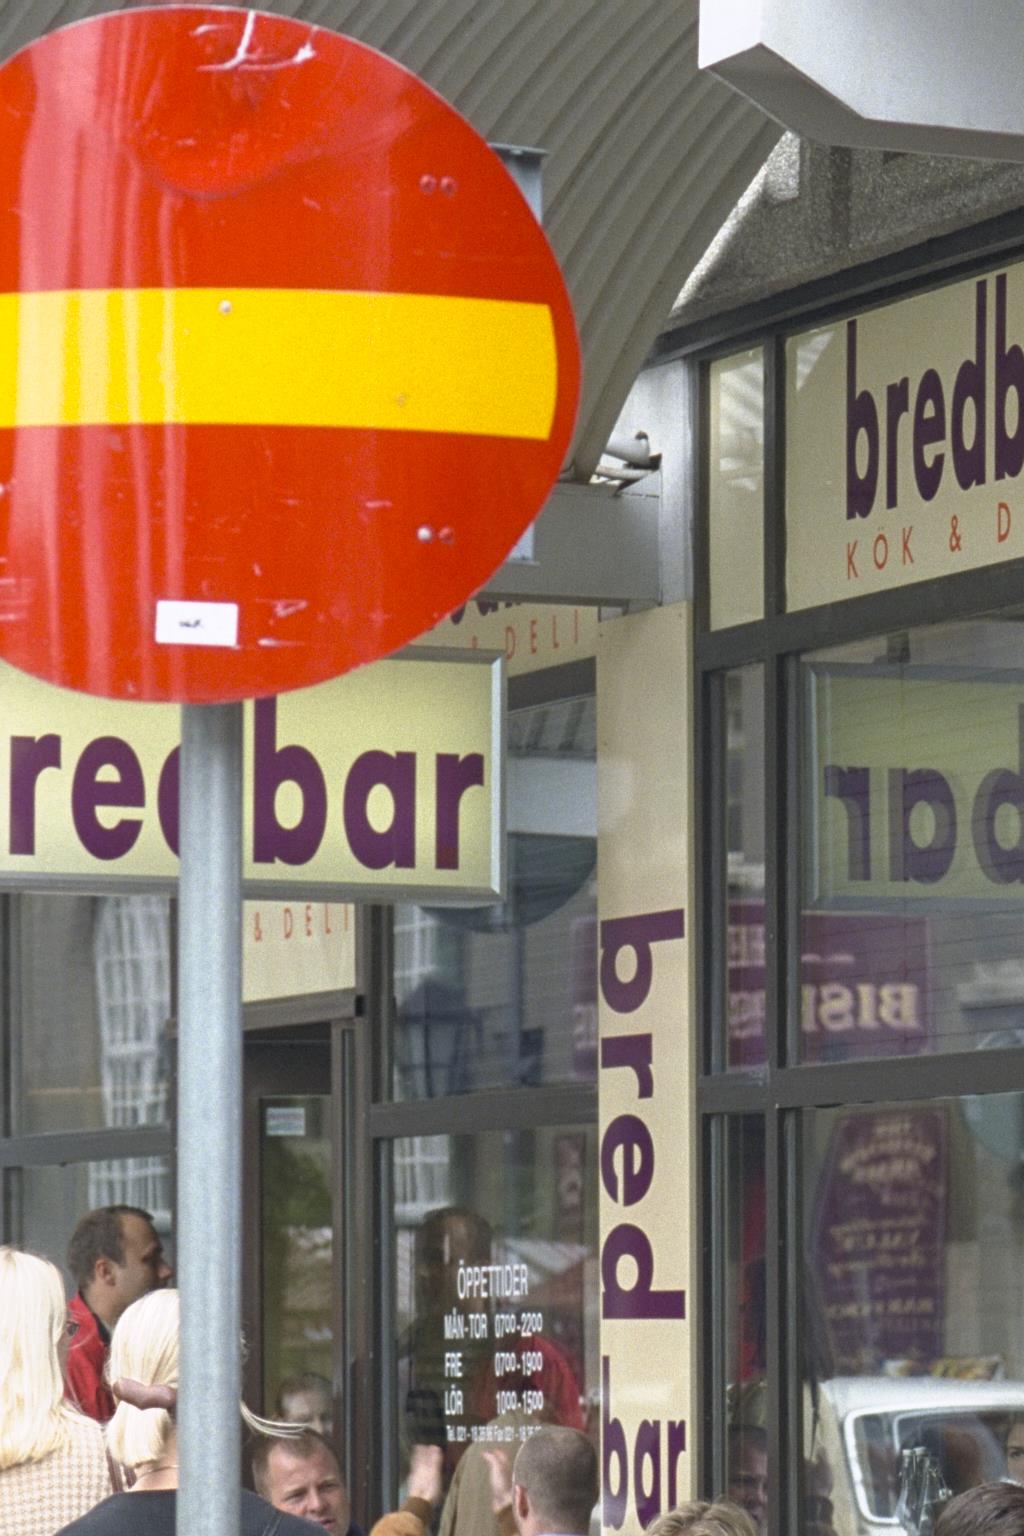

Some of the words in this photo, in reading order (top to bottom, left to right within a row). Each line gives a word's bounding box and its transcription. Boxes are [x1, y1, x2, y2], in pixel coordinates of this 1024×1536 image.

[846, 525, 914, 580] KÖK
[949, 514, 962, 552] &
[504, 608, 578, 662] DELI
[283, 902, 349, 939] DELI
[600, 907, 687, 1320] bred
[457, 1259, 529, 1300] ÖPPETTIDER
[444, 1352, 463, 1378] FRE
[444, 1384, 464, 1416] LÖR
[602, 1355, 686, 1531] bar
